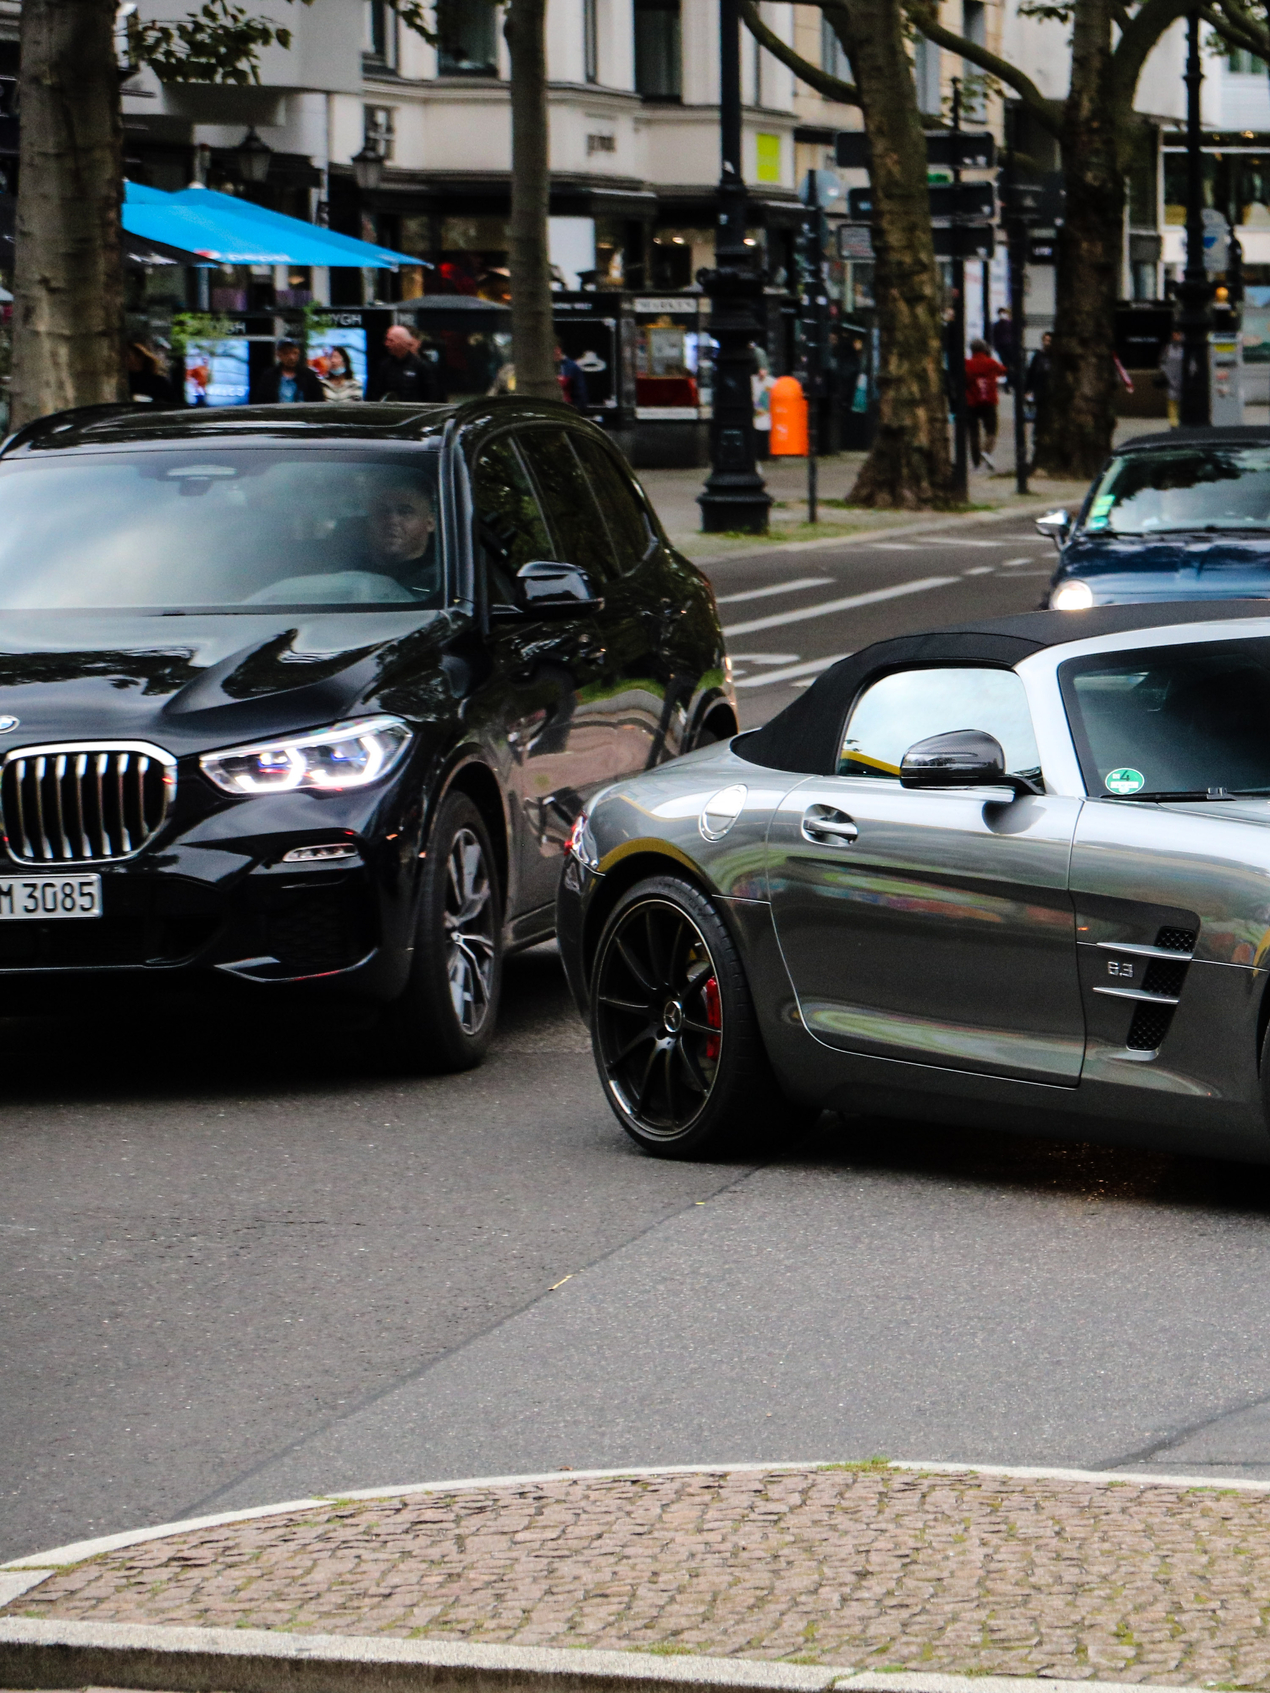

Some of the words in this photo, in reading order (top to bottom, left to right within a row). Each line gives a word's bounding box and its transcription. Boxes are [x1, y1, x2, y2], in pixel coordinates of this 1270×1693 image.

[1120, 770, 1130, 781] 4
[22, 881, 95, 914] 3085
[1107, 961, 1134, 978] 6.3
